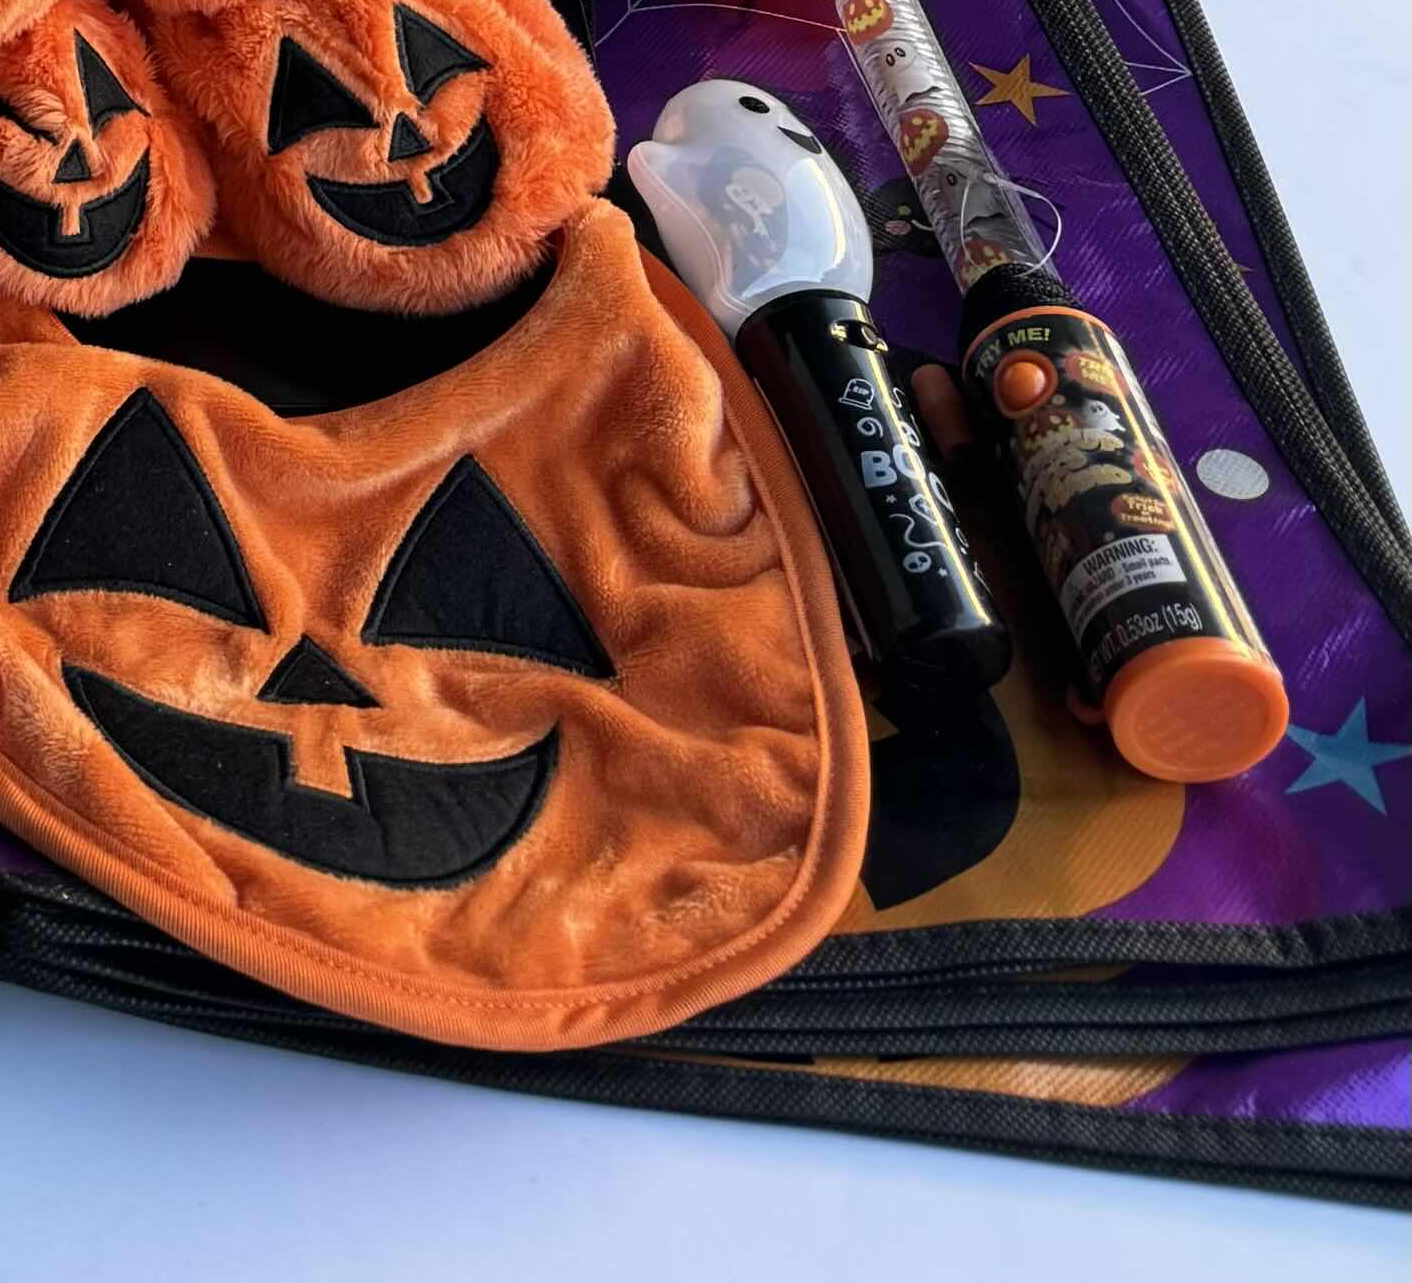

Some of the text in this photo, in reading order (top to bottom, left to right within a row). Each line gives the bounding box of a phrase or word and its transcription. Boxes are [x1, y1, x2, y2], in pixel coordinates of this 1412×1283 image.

[1007, 327, 1051, 349] ME!
[1082, 538, 1158, 577] WARNING:
[1162, 602, 1203, 633] (15g)
